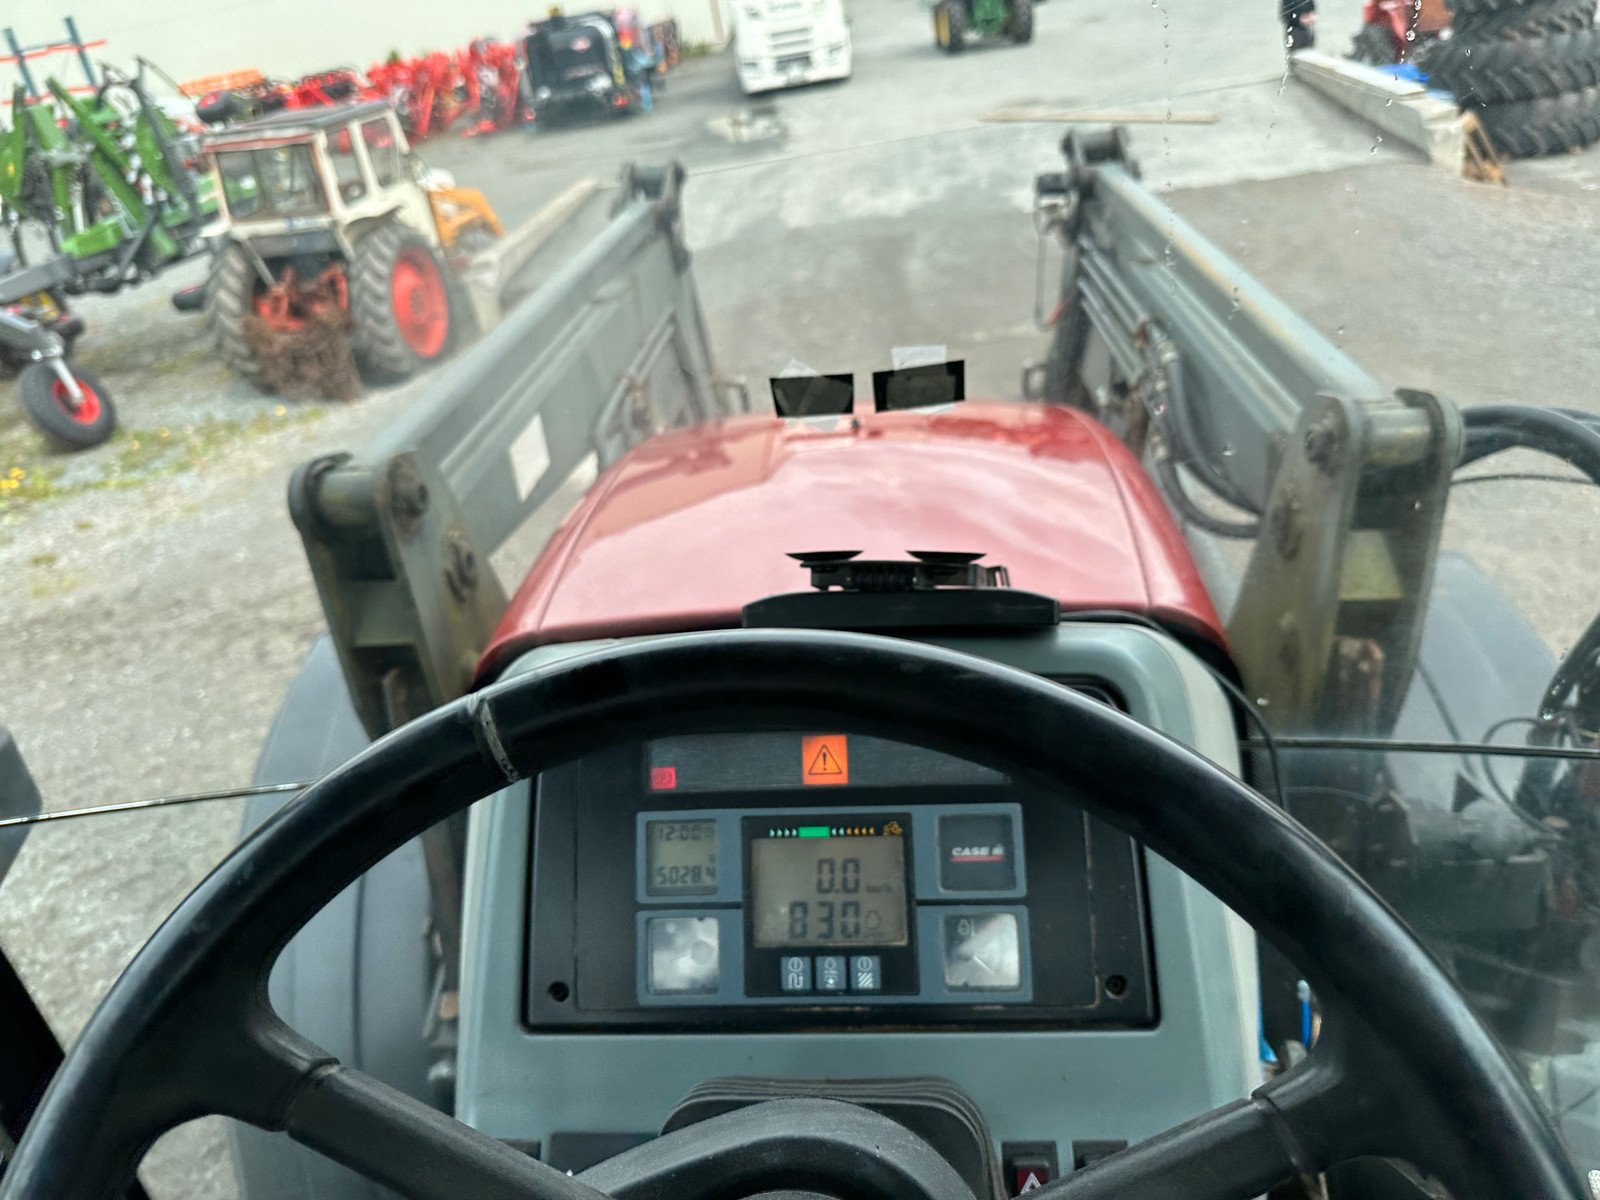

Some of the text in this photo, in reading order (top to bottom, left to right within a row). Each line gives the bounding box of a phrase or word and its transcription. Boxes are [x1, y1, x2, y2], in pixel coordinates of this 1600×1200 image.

[951, 846, 989, 856] CASE
[817, 858, 860, 893] 0.0
[788, 901, 860, 939] 830
